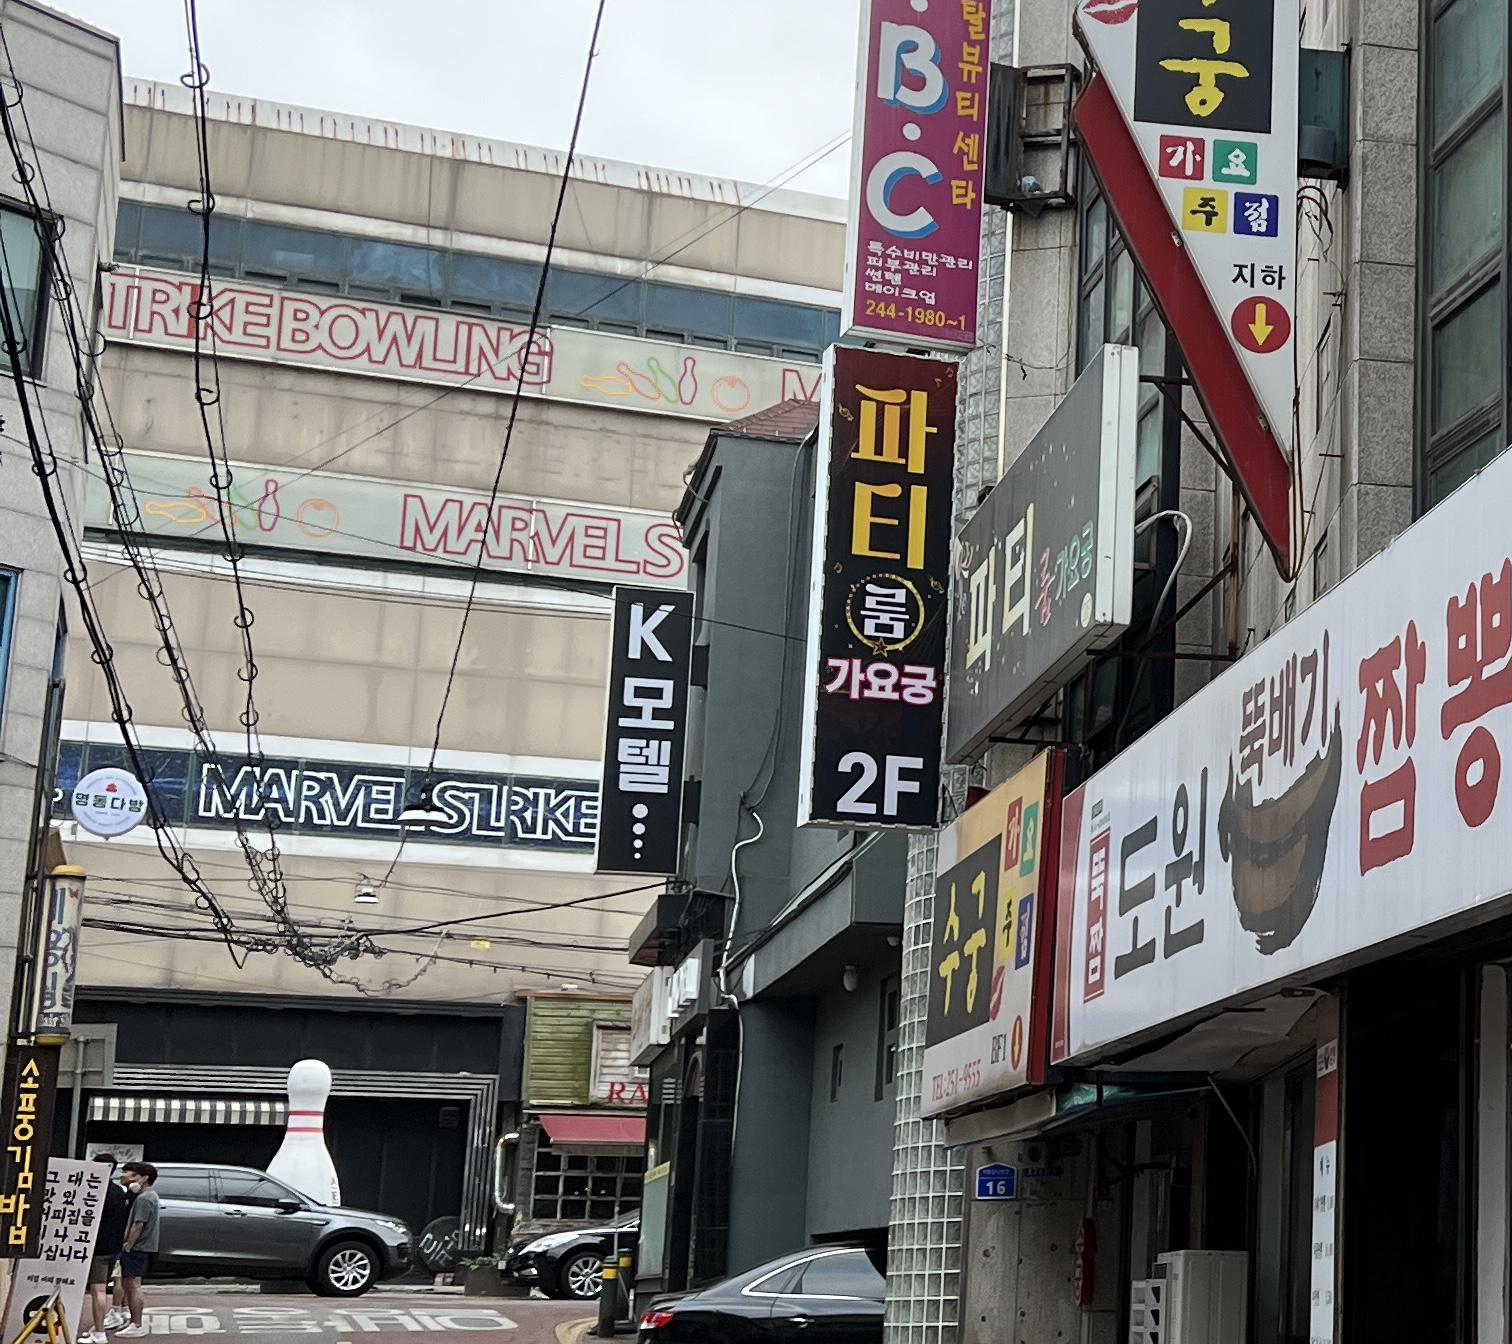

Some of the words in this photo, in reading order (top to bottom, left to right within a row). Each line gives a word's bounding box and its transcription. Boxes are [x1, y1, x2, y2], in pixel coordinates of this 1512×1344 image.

[1231, 262, 1287, 291] 지하
[279, 296, 554, 386] BOWLING
[824, 658, 937, 705] 가요궁
[1239, 629, 1332, 786] 뚝배기
[837, 751, 925, 816] 2F
[1114, 766, 1208, 980] 도원
[0, 1058, 40, 1246] 소풍김밥
[986, 1180, 1006, 1195] 16
[39, 1243, 89, 1263] 십니다
